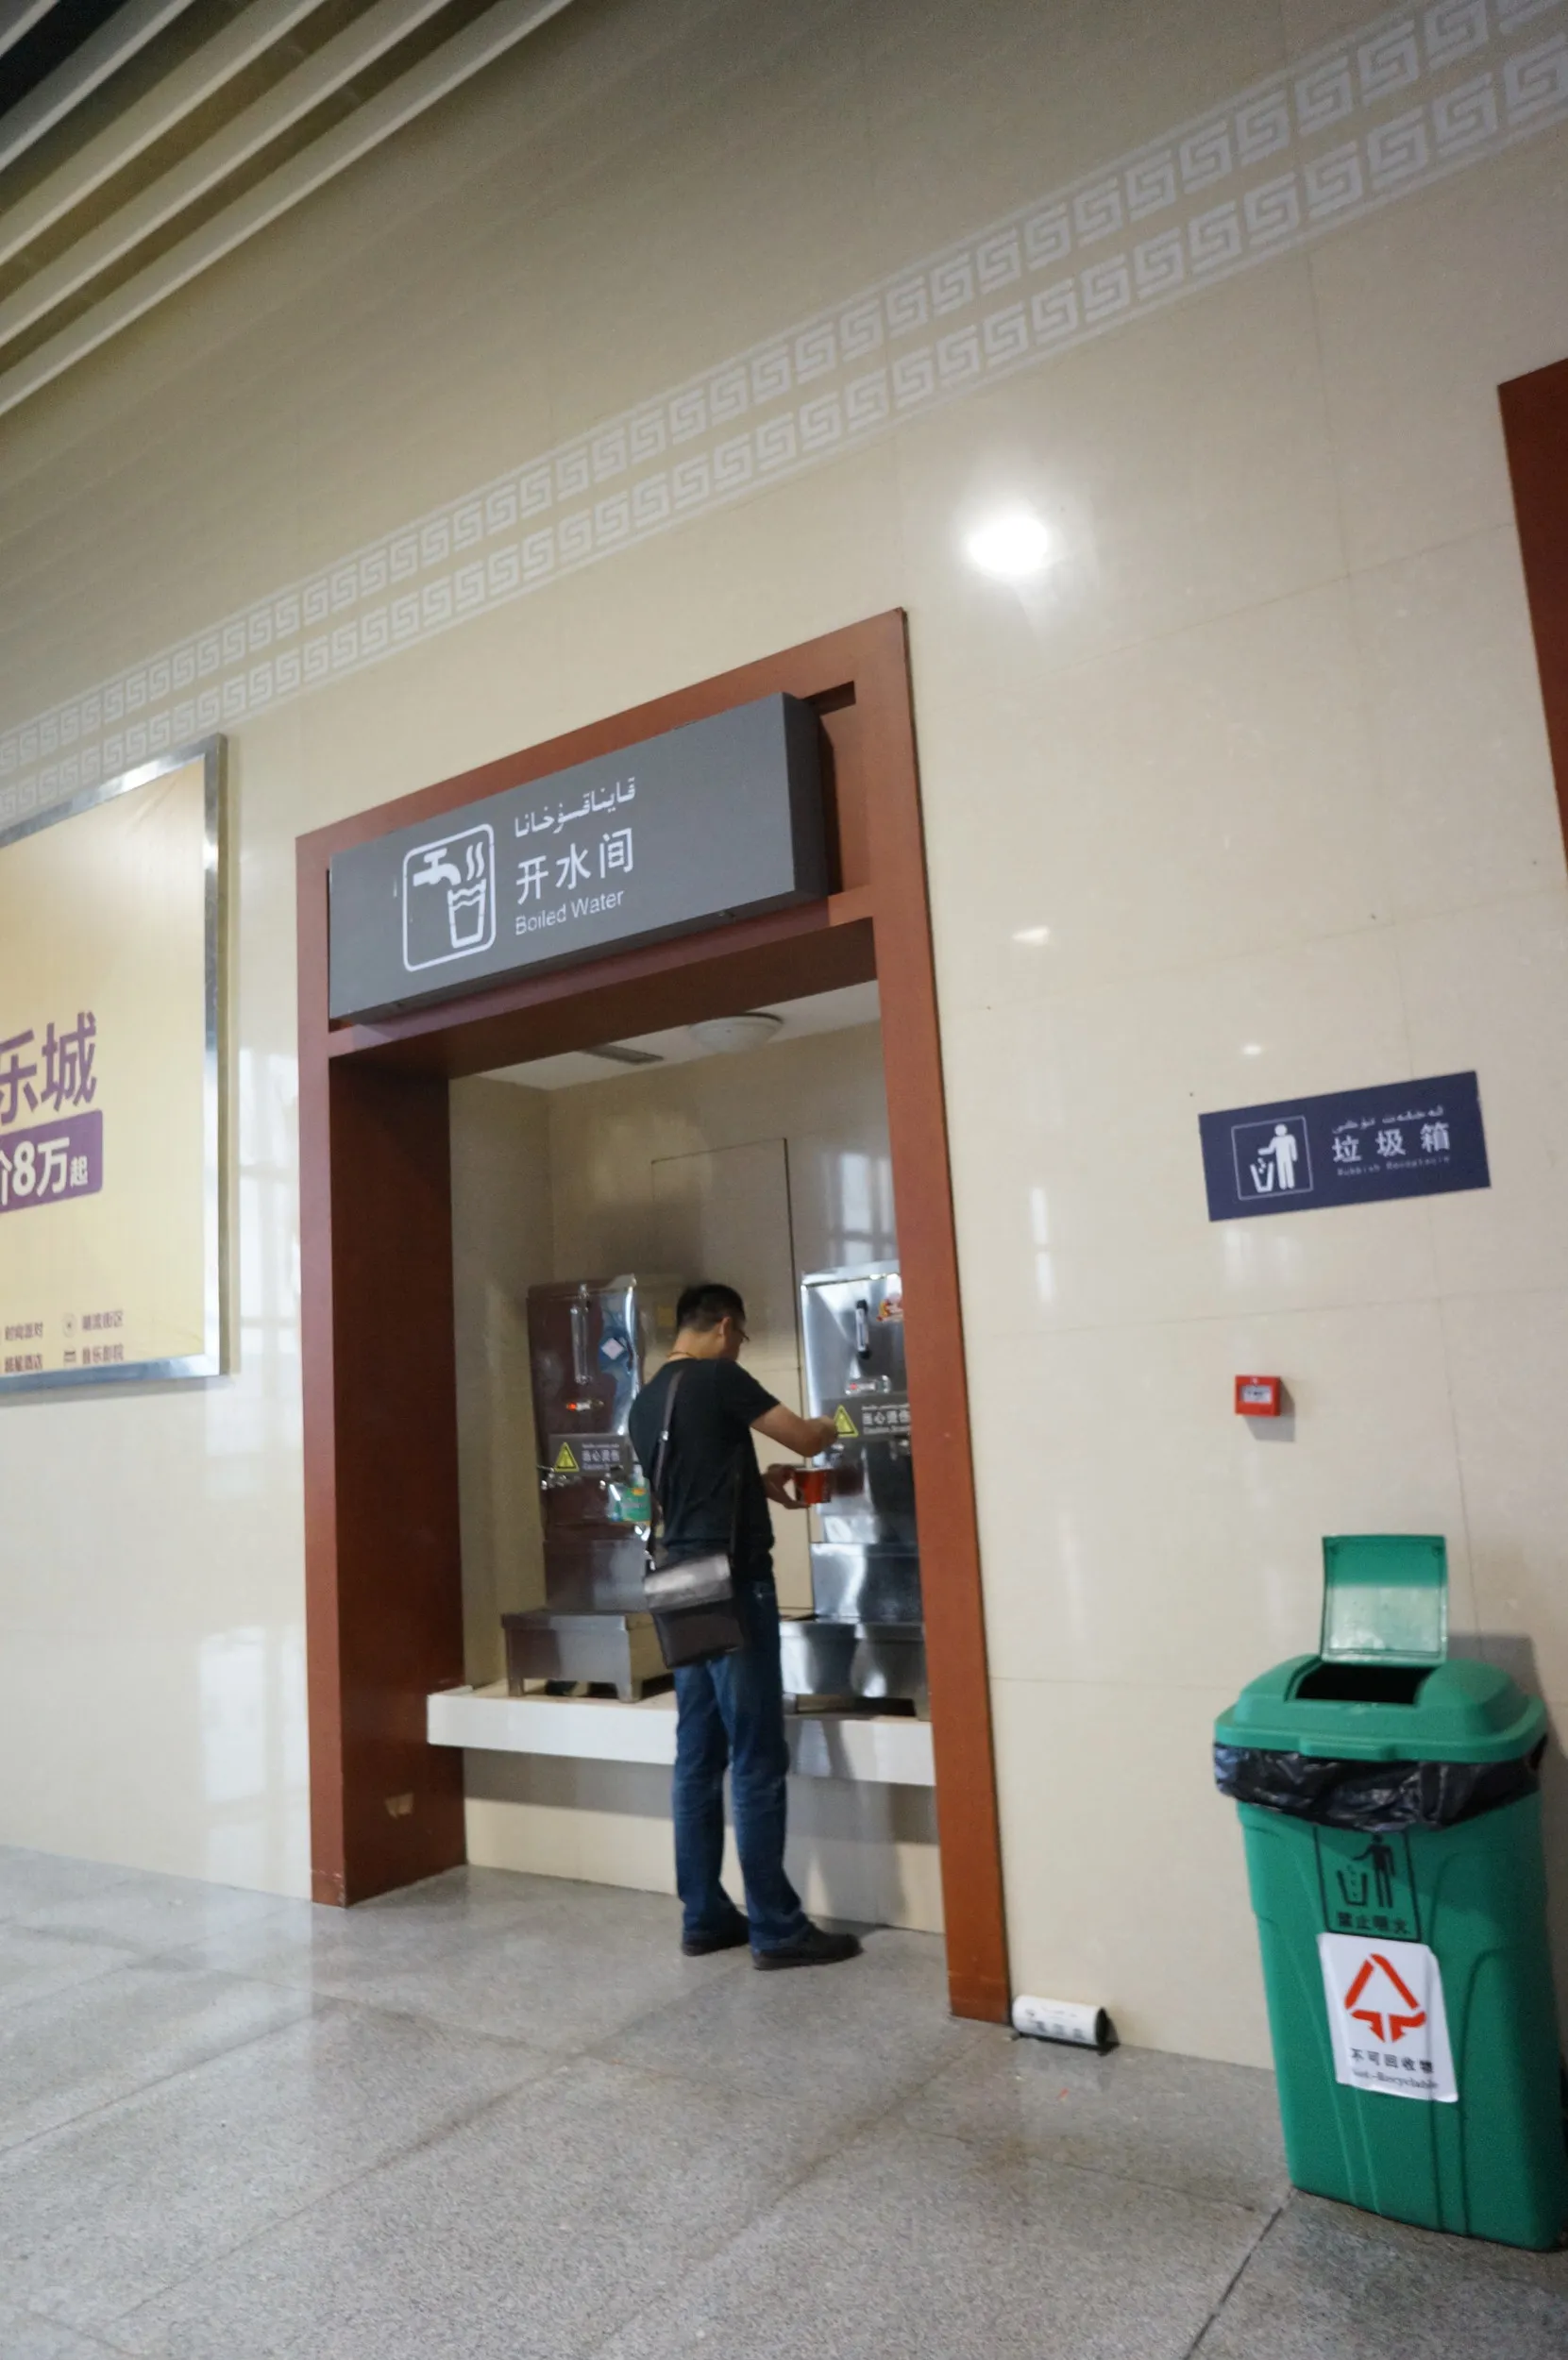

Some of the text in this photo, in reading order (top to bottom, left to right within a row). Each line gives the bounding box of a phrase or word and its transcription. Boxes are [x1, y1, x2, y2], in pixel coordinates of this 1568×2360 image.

[515, 827, 633, 905] 开水间
[515, 889, 625, 936] Boiled Water
[1331, 1121, 1451, 1163] 垃圾箱
[1351, 2048, 1434, 2075] 不可回收物
